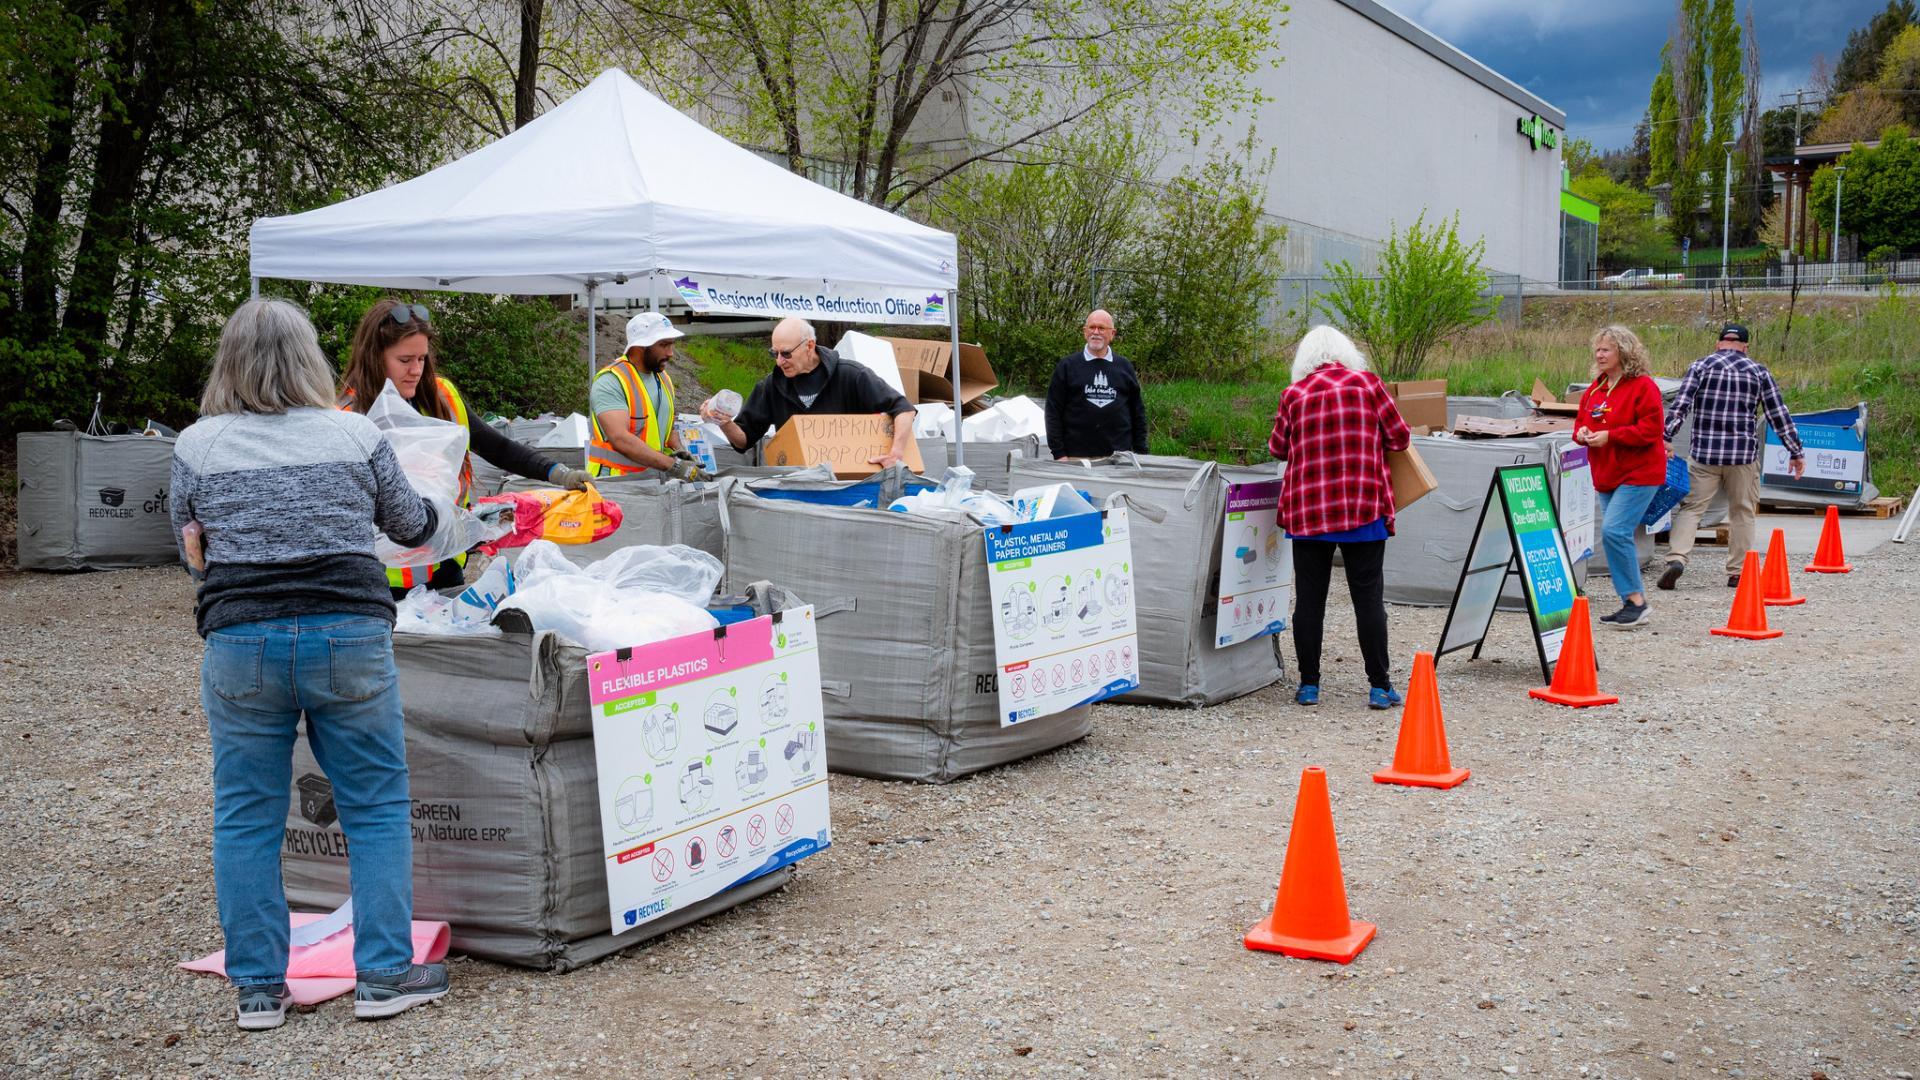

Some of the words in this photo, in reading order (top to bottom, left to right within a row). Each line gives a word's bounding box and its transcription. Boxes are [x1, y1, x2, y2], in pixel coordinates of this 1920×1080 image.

[707, 288, 768, 310] Regional
[770, 292, 814, 311] Waste
[816, 295, 882, 315] Reduction
[885, 297, 921, 316] Office
[800, 417, 879, 439] PUMPKIN
[808, 445, 850, 466] DROP
[1506, 476, 1543, 494] WELCOME
[143, 500, 168, 514] GFL
[1513, 510, 1537, 525] One-day
[1536, 508, 1550, 523] Only
[994, 536, 1029, 549] PLASTIC,
[1030, 532, 1054, 544] METAL
[1055, 529, 1069, 540] AND
[995, 547, 1021, 560] PAPER
[1022, 541, 1066, 556] CONTAINERS
[1526, 547, 1557, 563] RECYCLING
[1534, 561, 1557, 580] DEPOT
[1537, 577, 1563, 596] POP-UP
[602, 670, 656, 694] FLEXIBLE
[657, 658, 708, 681] PLASTICS
[615, 698, 647, 711] ACCEPTED
[411, 799, 461, 821] GREEN
[428, 823, 478, 840] Nature
[631, 847, 651, 858] ACCEPTED
